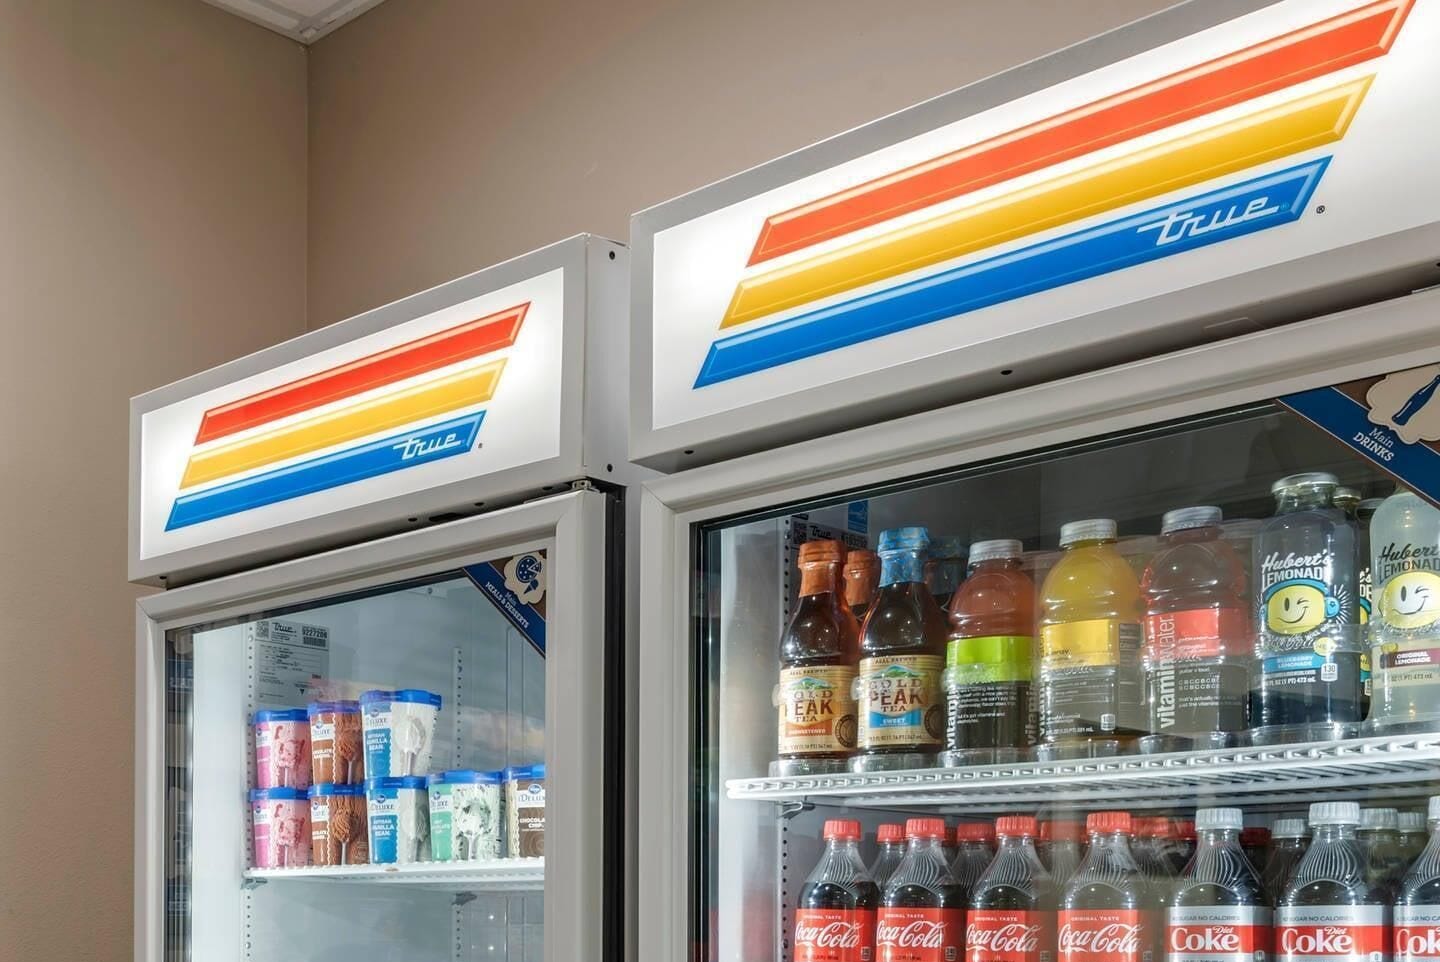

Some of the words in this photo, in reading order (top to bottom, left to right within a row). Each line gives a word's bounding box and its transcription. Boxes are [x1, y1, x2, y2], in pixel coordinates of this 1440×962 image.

[1137, 197, 1279, 246] true
[393, 433, 464, 460] true
[1353, 432, 1395, 462] DRINKS
[1369, 427, 1394, 448] Main
[1262, 549, 1335, 572] Hubert's
[504, 602, 529, 628] DESSERTS
[1395, 656, 1432, 665] LEMONADE
[1397, 651, 1429, 659] ORIGINAL
[1323, 665, 1336, 673] 130
[868, 679, 922, 689] GOLD
[869, 689, 924, 706] PEAK
[795, 920, 864, 948] Coca-Cola
[876, 920, 949, 948] Coca-Cola
[966, 923, 1042, 952] Coca-Cola
[1058, 923, 1143, 952] Coca-Cola
[1171, 927, 1240, 951] Coke
[1212, 925, 1233, 934] Diet
[1282, 928, 1354, 953] Coke
[1324, 926, 1347, 935] Diet
[1396, 928, 1440, 954] Cok
